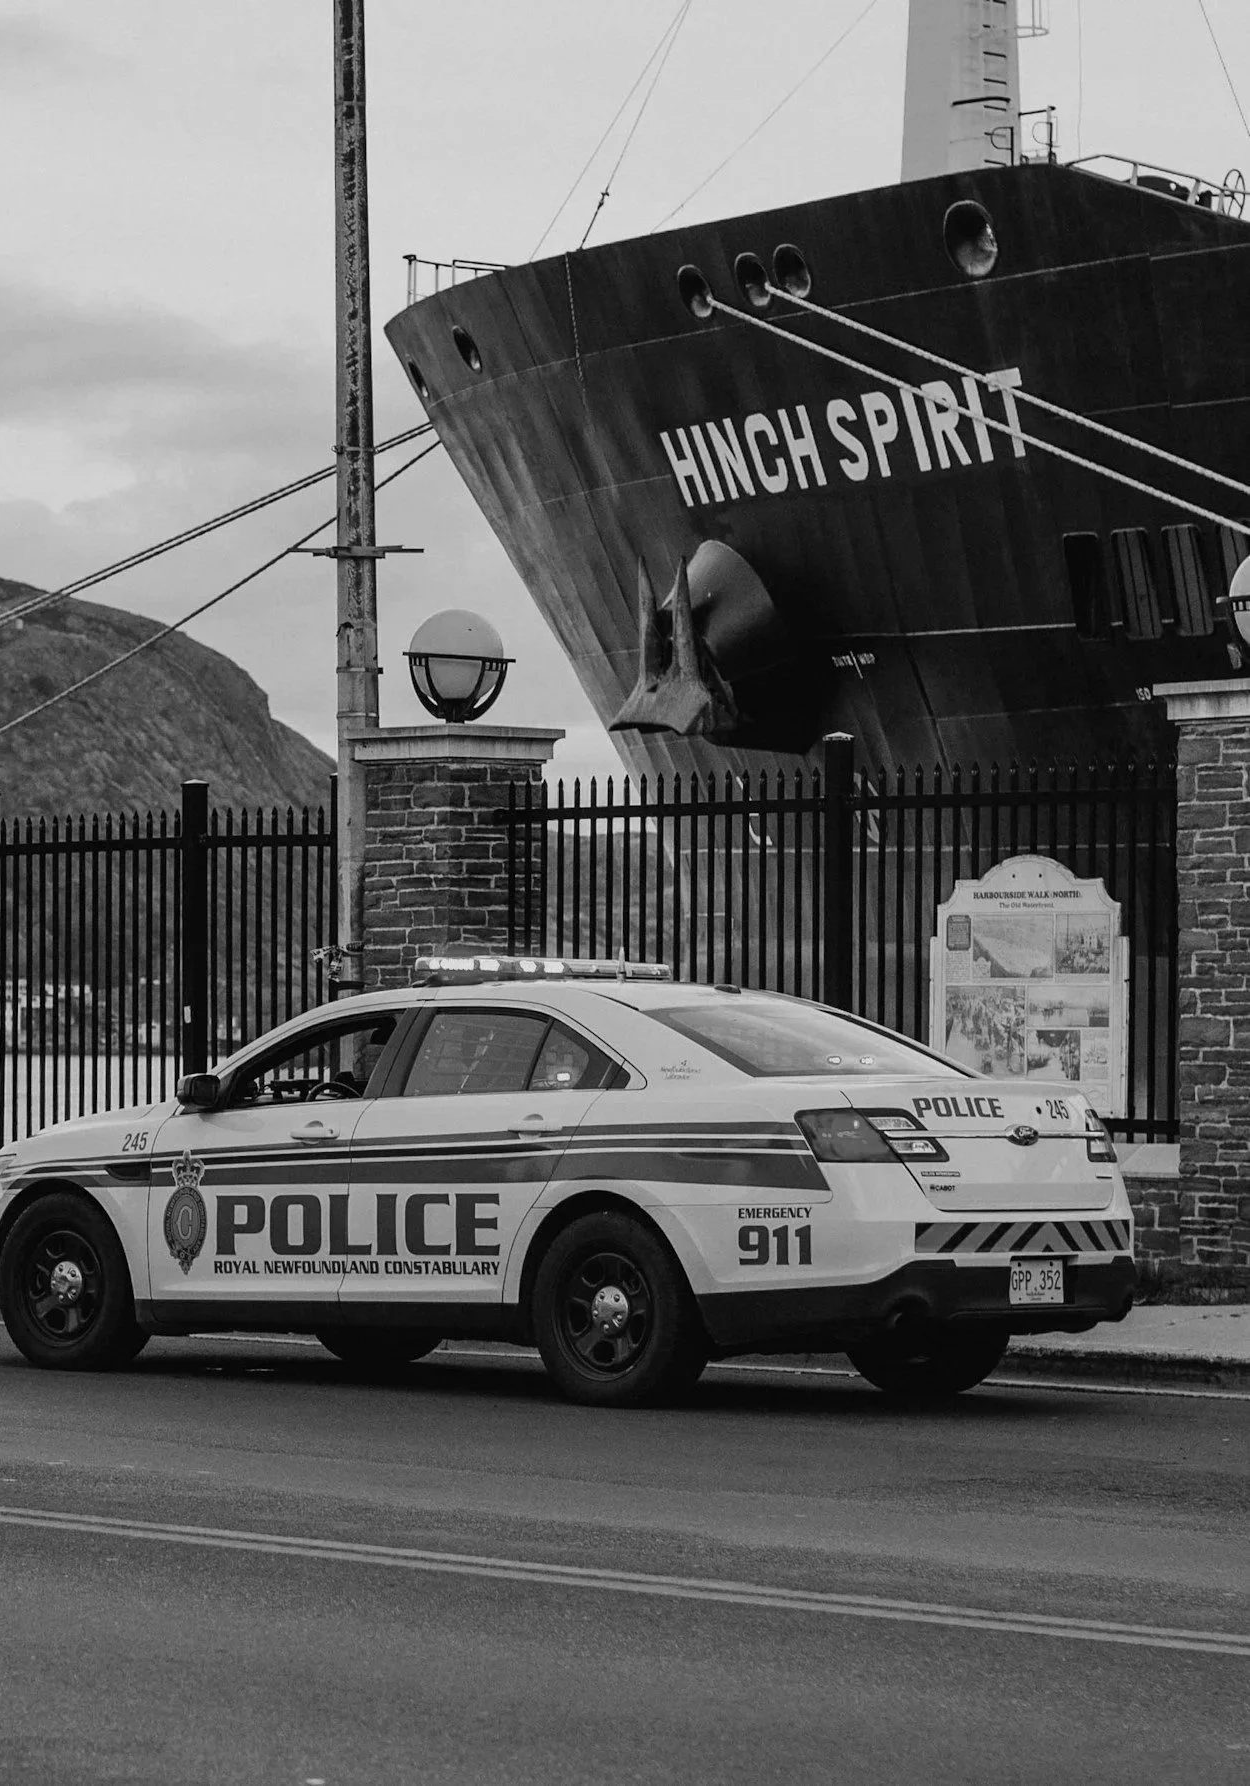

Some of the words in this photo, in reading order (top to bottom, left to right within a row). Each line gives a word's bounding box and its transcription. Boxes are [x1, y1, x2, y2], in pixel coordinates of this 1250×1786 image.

[659, 403, 828, 508] HINCH
[826, 367, 1026, 483] SPIRIT
[973, 891, 1026, 900] HARBOURSIDE
[1027, 890, 1050, 899] WALK
[911, 1096, 1005, 1120] POLICE
[1045, 1099, 1070, 1120] 245
[121, 1131, 149, 1153] 245
[935, 1184, 956, 1192] CABOT
[215, 1192, 501, 1257] POLICE
[737, 1207, 813, 1220] EMERGENCY
[737, 1224, 813, 1266] 911
[214, 1259, 261, 1275] ROYAL
[263, 1259, 380, 1275] NEWFOUNDLAND
[384, 1259, 501, 1276] CONSTABULARY
[1011, 1270, 1032, 1291] GPP
[1039, 1269, 1062, 1290] 352
